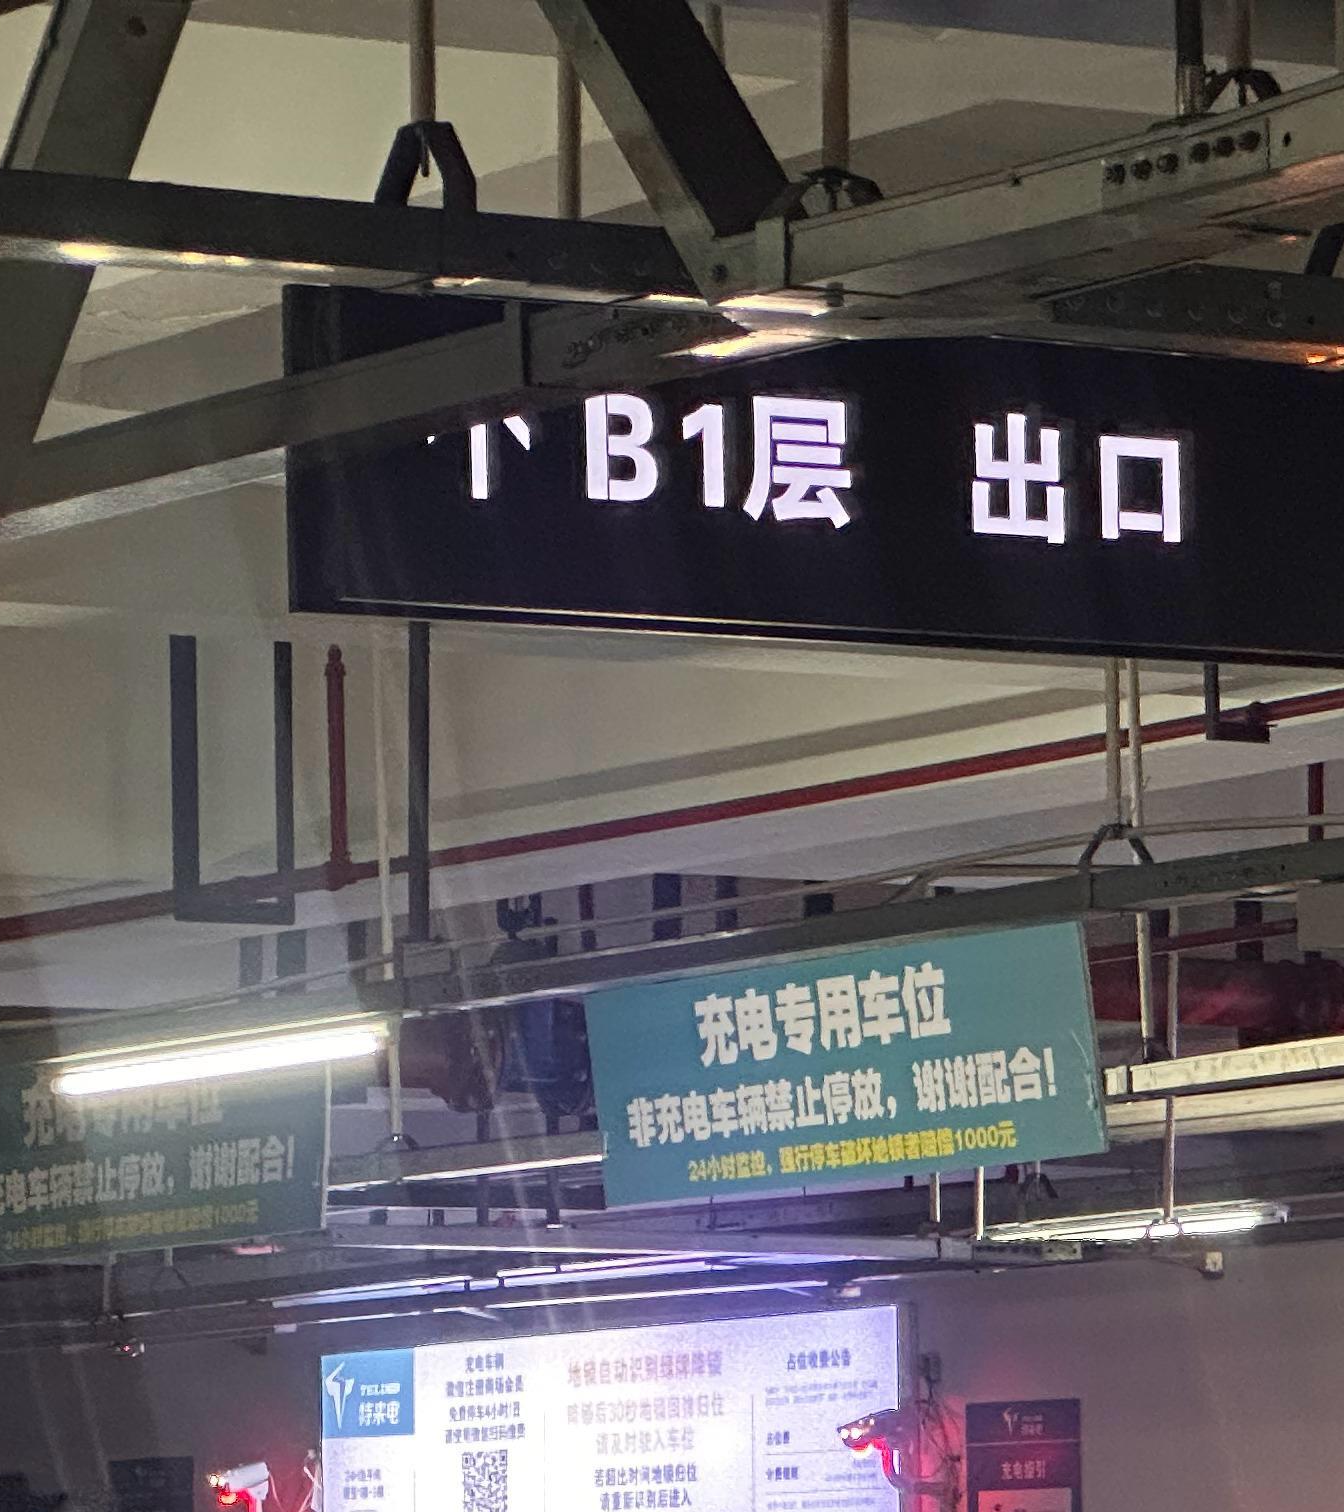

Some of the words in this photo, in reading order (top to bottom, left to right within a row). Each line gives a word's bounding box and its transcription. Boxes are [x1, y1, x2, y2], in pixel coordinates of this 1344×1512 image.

[586, 392, 851, 527] B1层
[972, 412, 1183, 545] 出口
[693, 961, 953, 1068] 充电专用车位
[359, 1401, 400, 1426] 特来电
